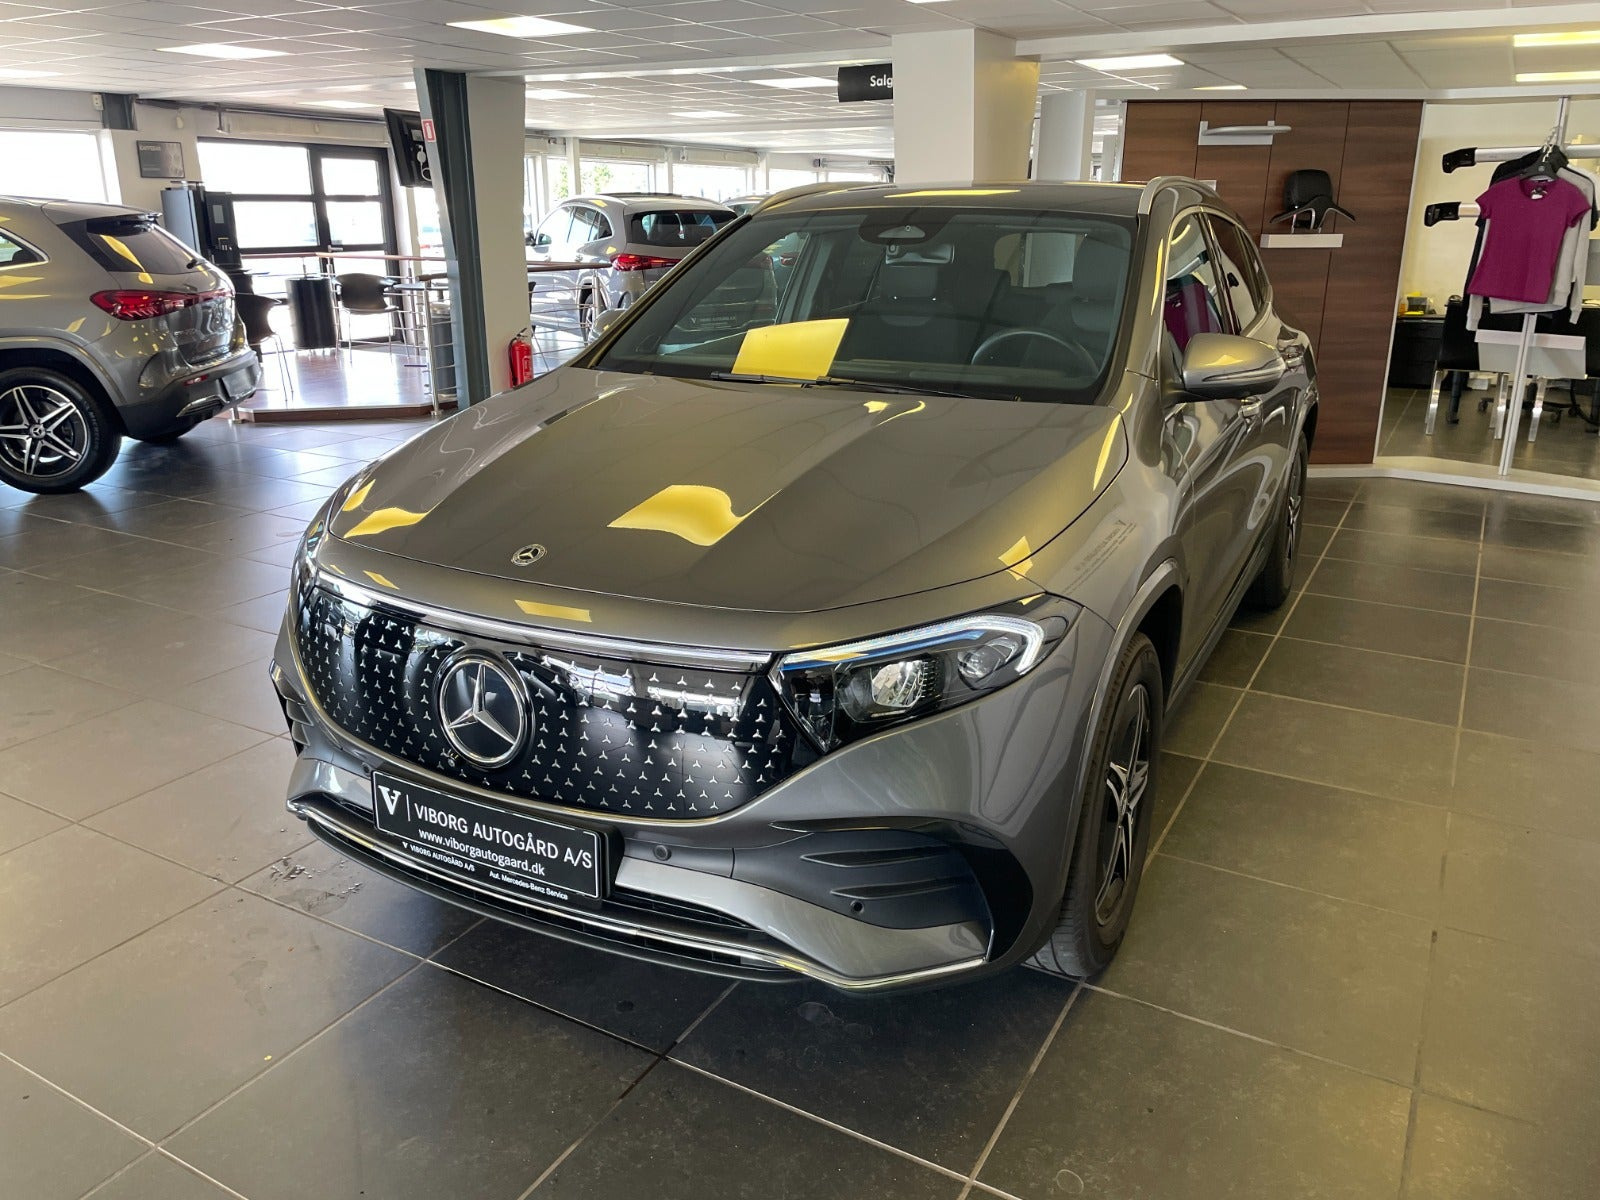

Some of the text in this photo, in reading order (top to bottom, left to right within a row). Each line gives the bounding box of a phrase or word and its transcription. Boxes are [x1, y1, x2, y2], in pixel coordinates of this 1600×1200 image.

[414, 803, 592, 868] VIBORG AUTOGÅRD A/S
[418, 828, 545, 876] www.viborgautogaard.dk
[409, 844, 431, 857] VIBORG
[432, 852, 463, 867] AUTOGÅRD
[464, 862, 475, 871] A/S
[501, 873, 545, 894] Mercedes-Benz
[545, 887, 568, 900] Service
